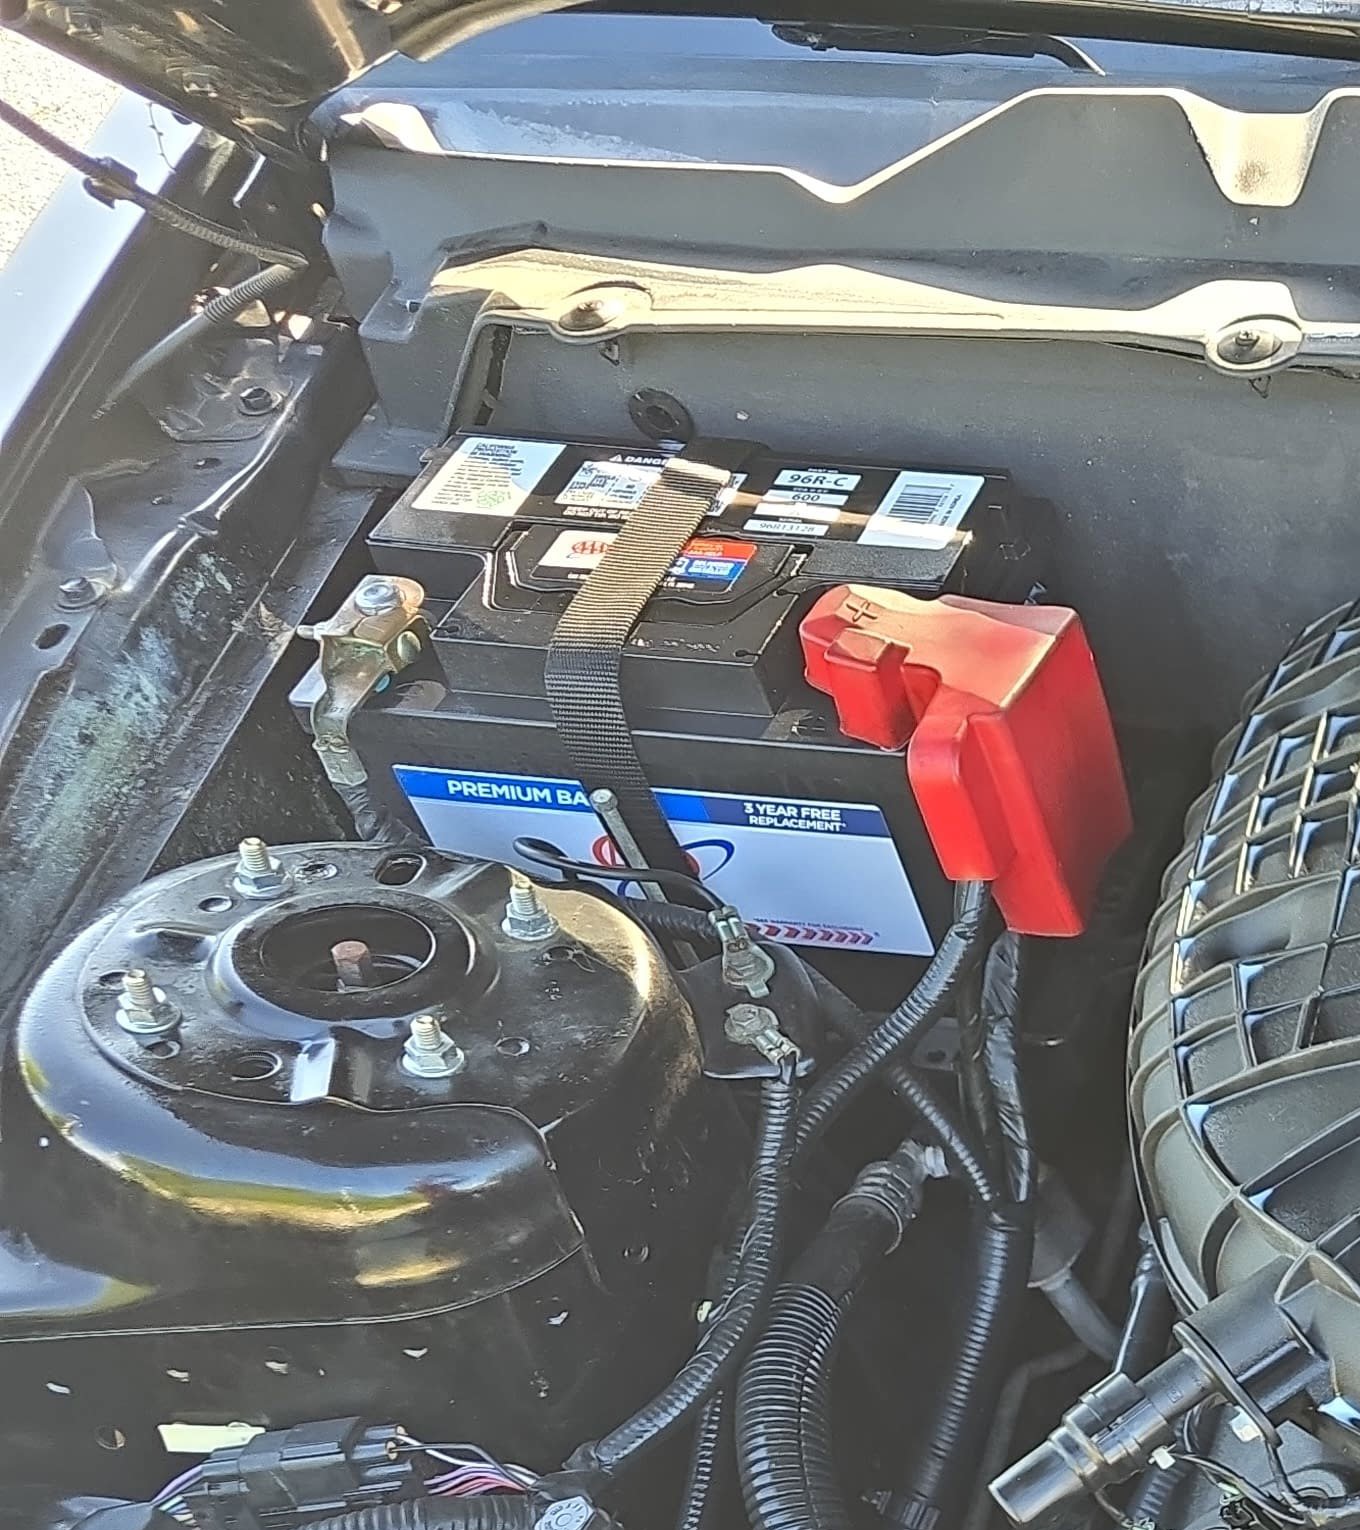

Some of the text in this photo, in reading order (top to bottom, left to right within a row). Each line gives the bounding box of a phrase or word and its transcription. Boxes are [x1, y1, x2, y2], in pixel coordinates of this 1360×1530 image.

[624, 455, 667, 466] DANGE
[788, 474, 848, 487] 96R-C
[792, 493, 821, 502] 600
[447, 779, 591, 808] PREMIUM BA
[743, 802, 841, 821] 3 YEAR FREE
